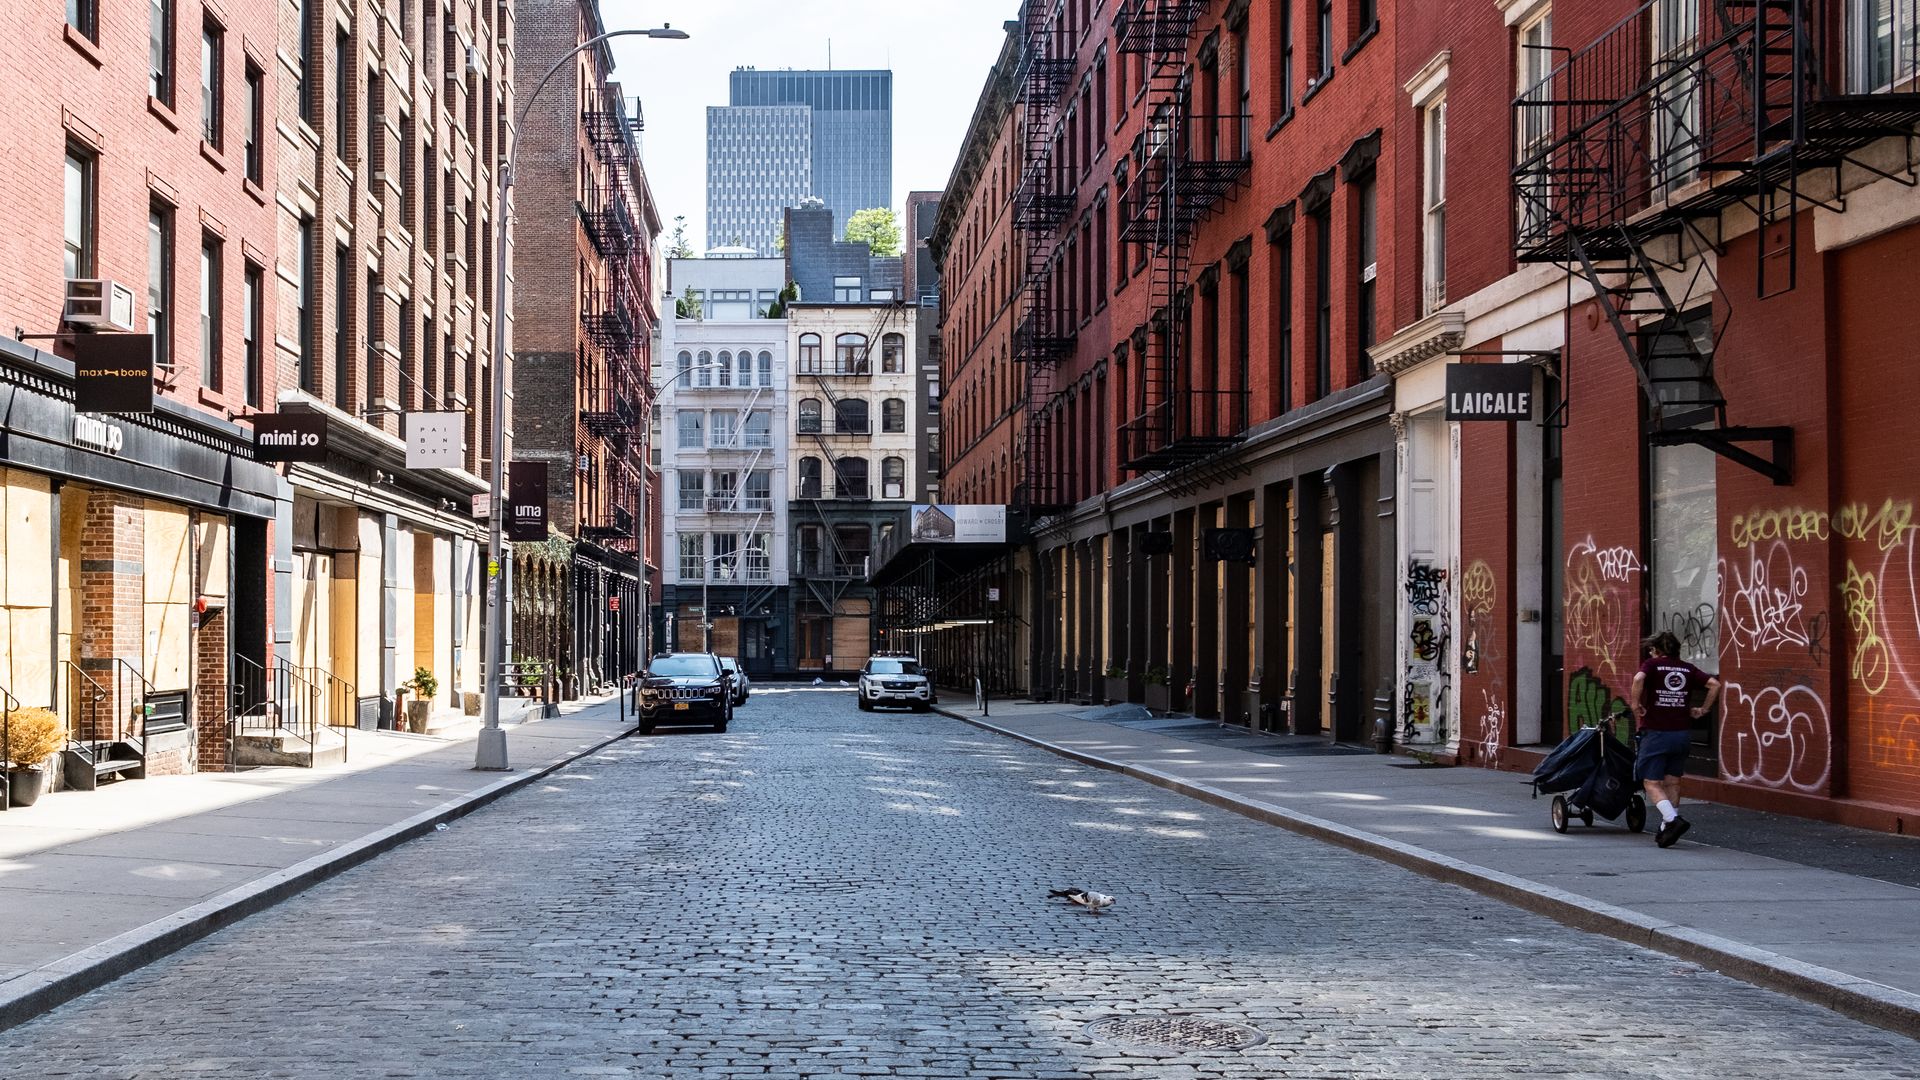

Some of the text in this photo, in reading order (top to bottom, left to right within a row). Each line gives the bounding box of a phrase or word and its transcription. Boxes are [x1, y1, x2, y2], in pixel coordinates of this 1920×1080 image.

[80, 368, 148, 377] max bone
[1451, 392, 1528, 414] LAICALE
[260, 429, 320, 446] mimi so
[515, 505, 541, 518] uma
